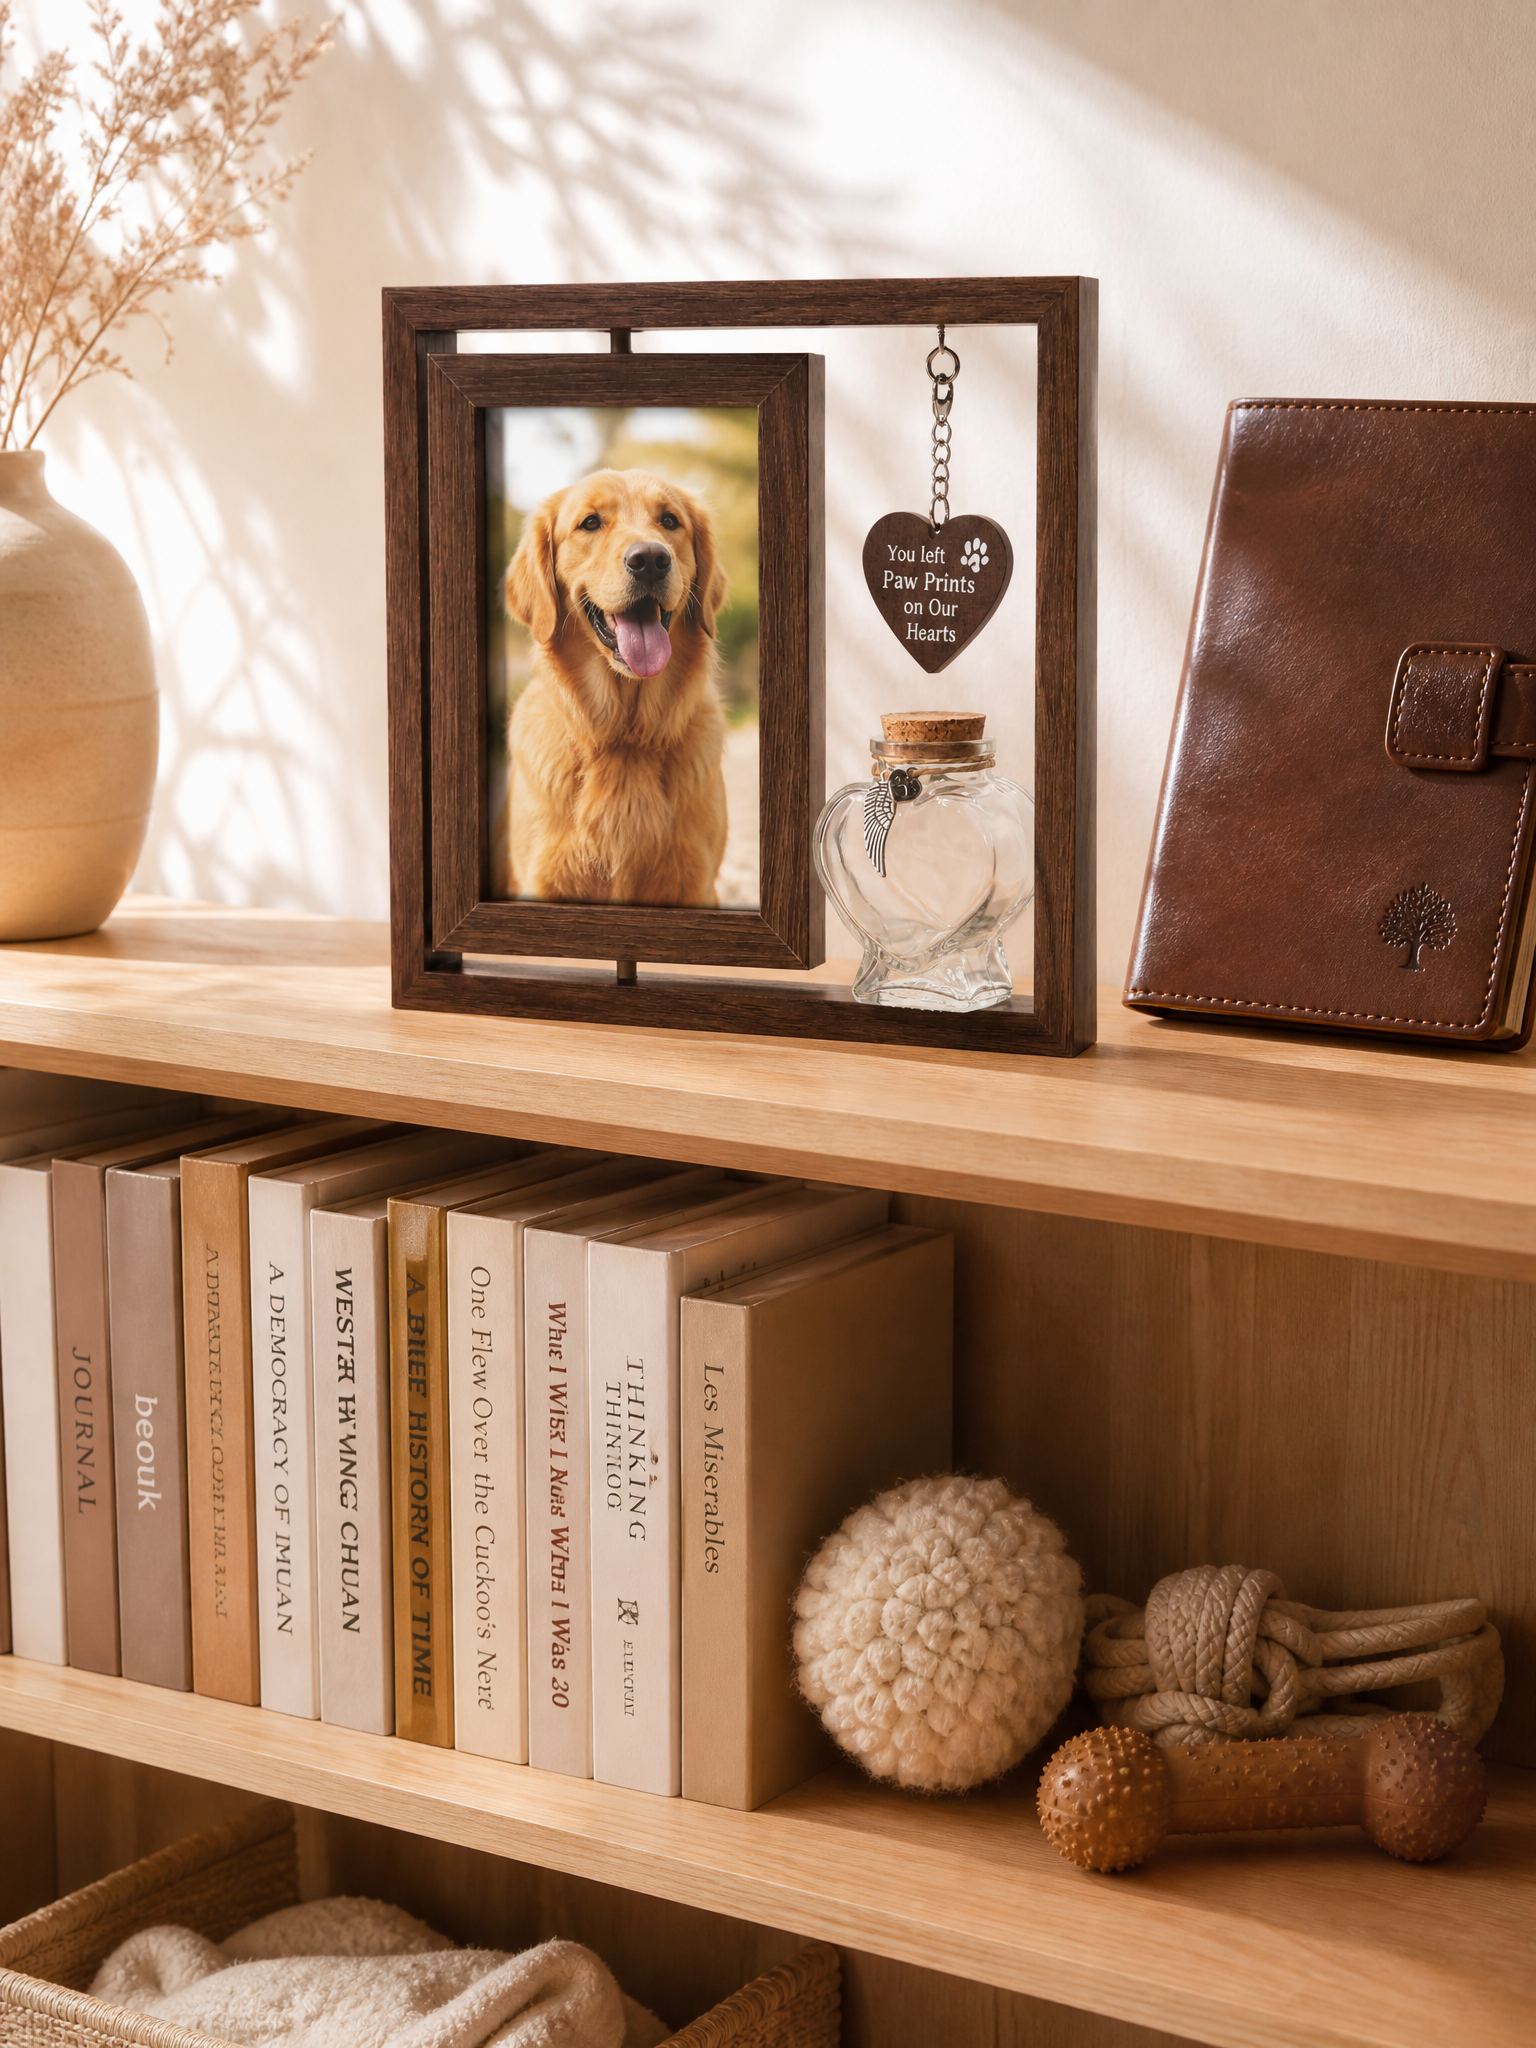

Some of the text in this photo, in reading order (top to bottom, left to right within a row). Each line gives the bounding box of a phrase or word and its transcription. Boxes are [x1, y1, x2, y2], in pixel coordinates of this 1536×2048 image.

[887, 544, 946, 564] You left
[882, 570, 975, 593] Paw Prints
[904, 599, 958, 616] on Our
[906, 622, 956, 642] Hearts
[268, 1262, 285, 1285] A
[406, 1272, 426, 1298] A
[470, 1266, 491, 1319] One
[472, 1327, 492, 1390] Flew
[270, 1294, 288, 1476] DEMOCRACY
[71, 1346, 97, 1515] JOURNAL
[134, 1393, 162, 1511] beouk
[472, 1397, 493, 1464] Over
[549, 1448, 567, 1458] I
[625, 1355, 646, 1542] THINKING
[474, 1473, 494, 1515] the
[703, 1362, 725, 1575] Les Miserables
[274, 1484, 290, 1525] OF
[340, 1521, 360, 1635] CHUAN
[411, 1557, 430, 1599] OF
[475, 1525, 496, 1639] Cuckoo's
[411, 1611, 431, 1697] TIME
[551, 1618, 570, 1670] Was
[551, 1677, 569, 1709] 20
